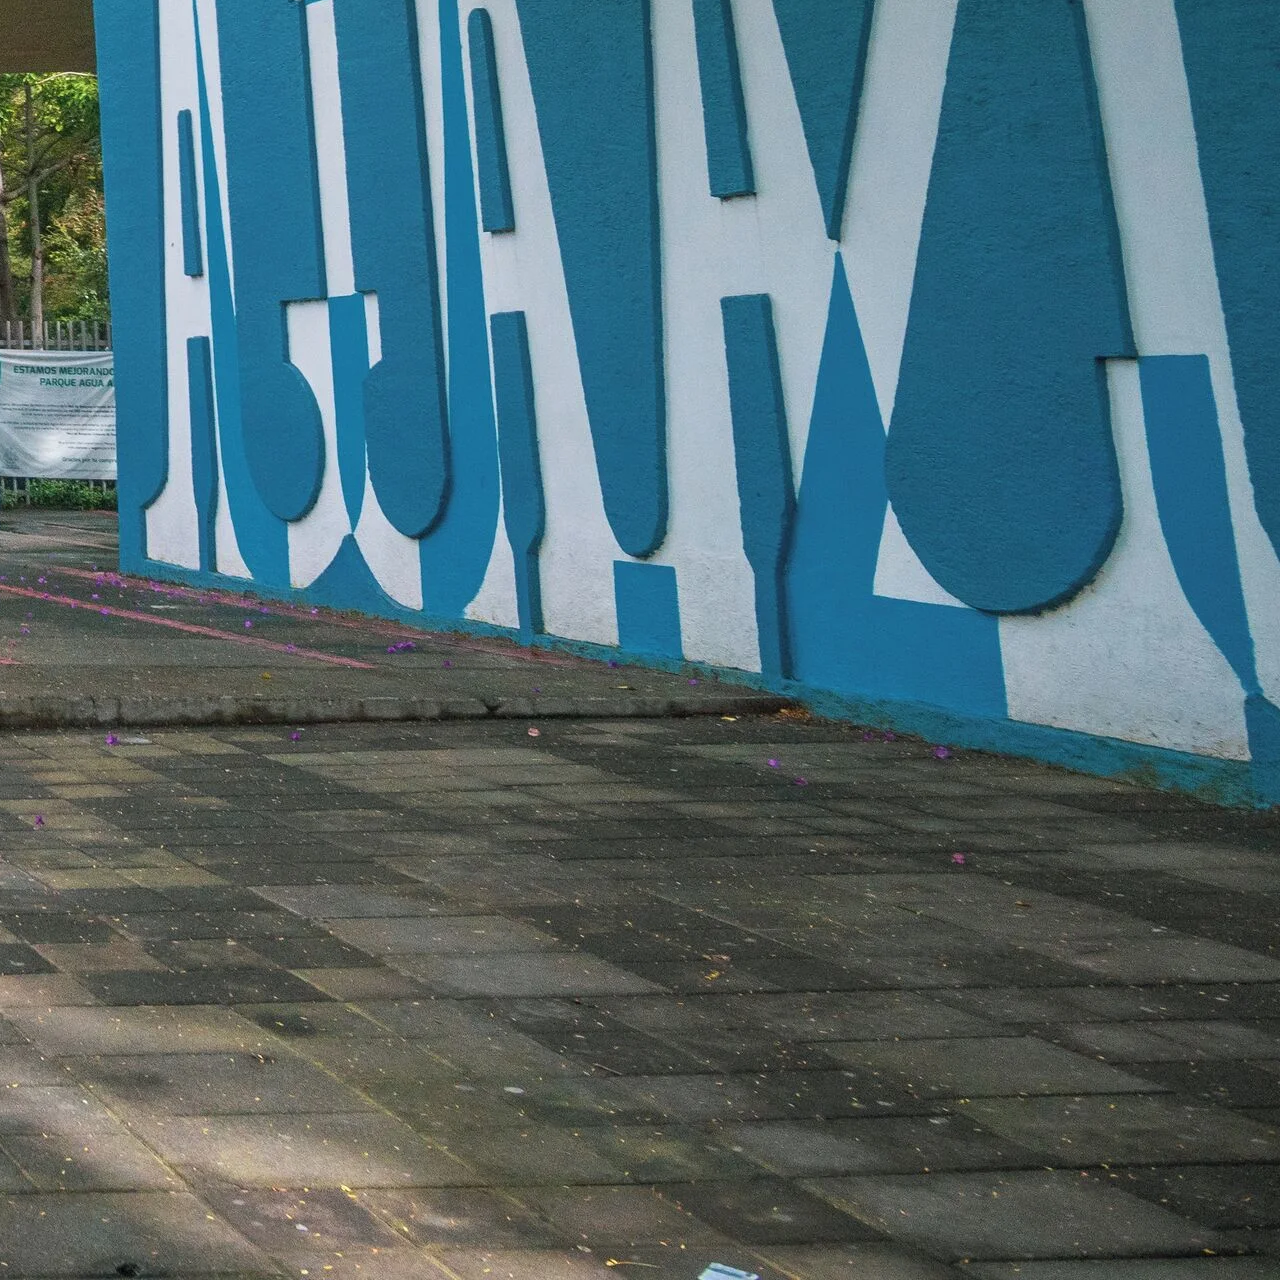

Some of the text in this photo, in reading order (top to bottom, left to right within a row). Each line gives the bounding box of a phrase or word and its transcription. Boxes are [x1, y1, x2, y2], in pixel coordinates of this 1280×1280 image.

[13, 365, 57, 375] ESTAMOS
[39, 377, 76, 388] PARQUE
[78, 379, 105, 388] AGUA
